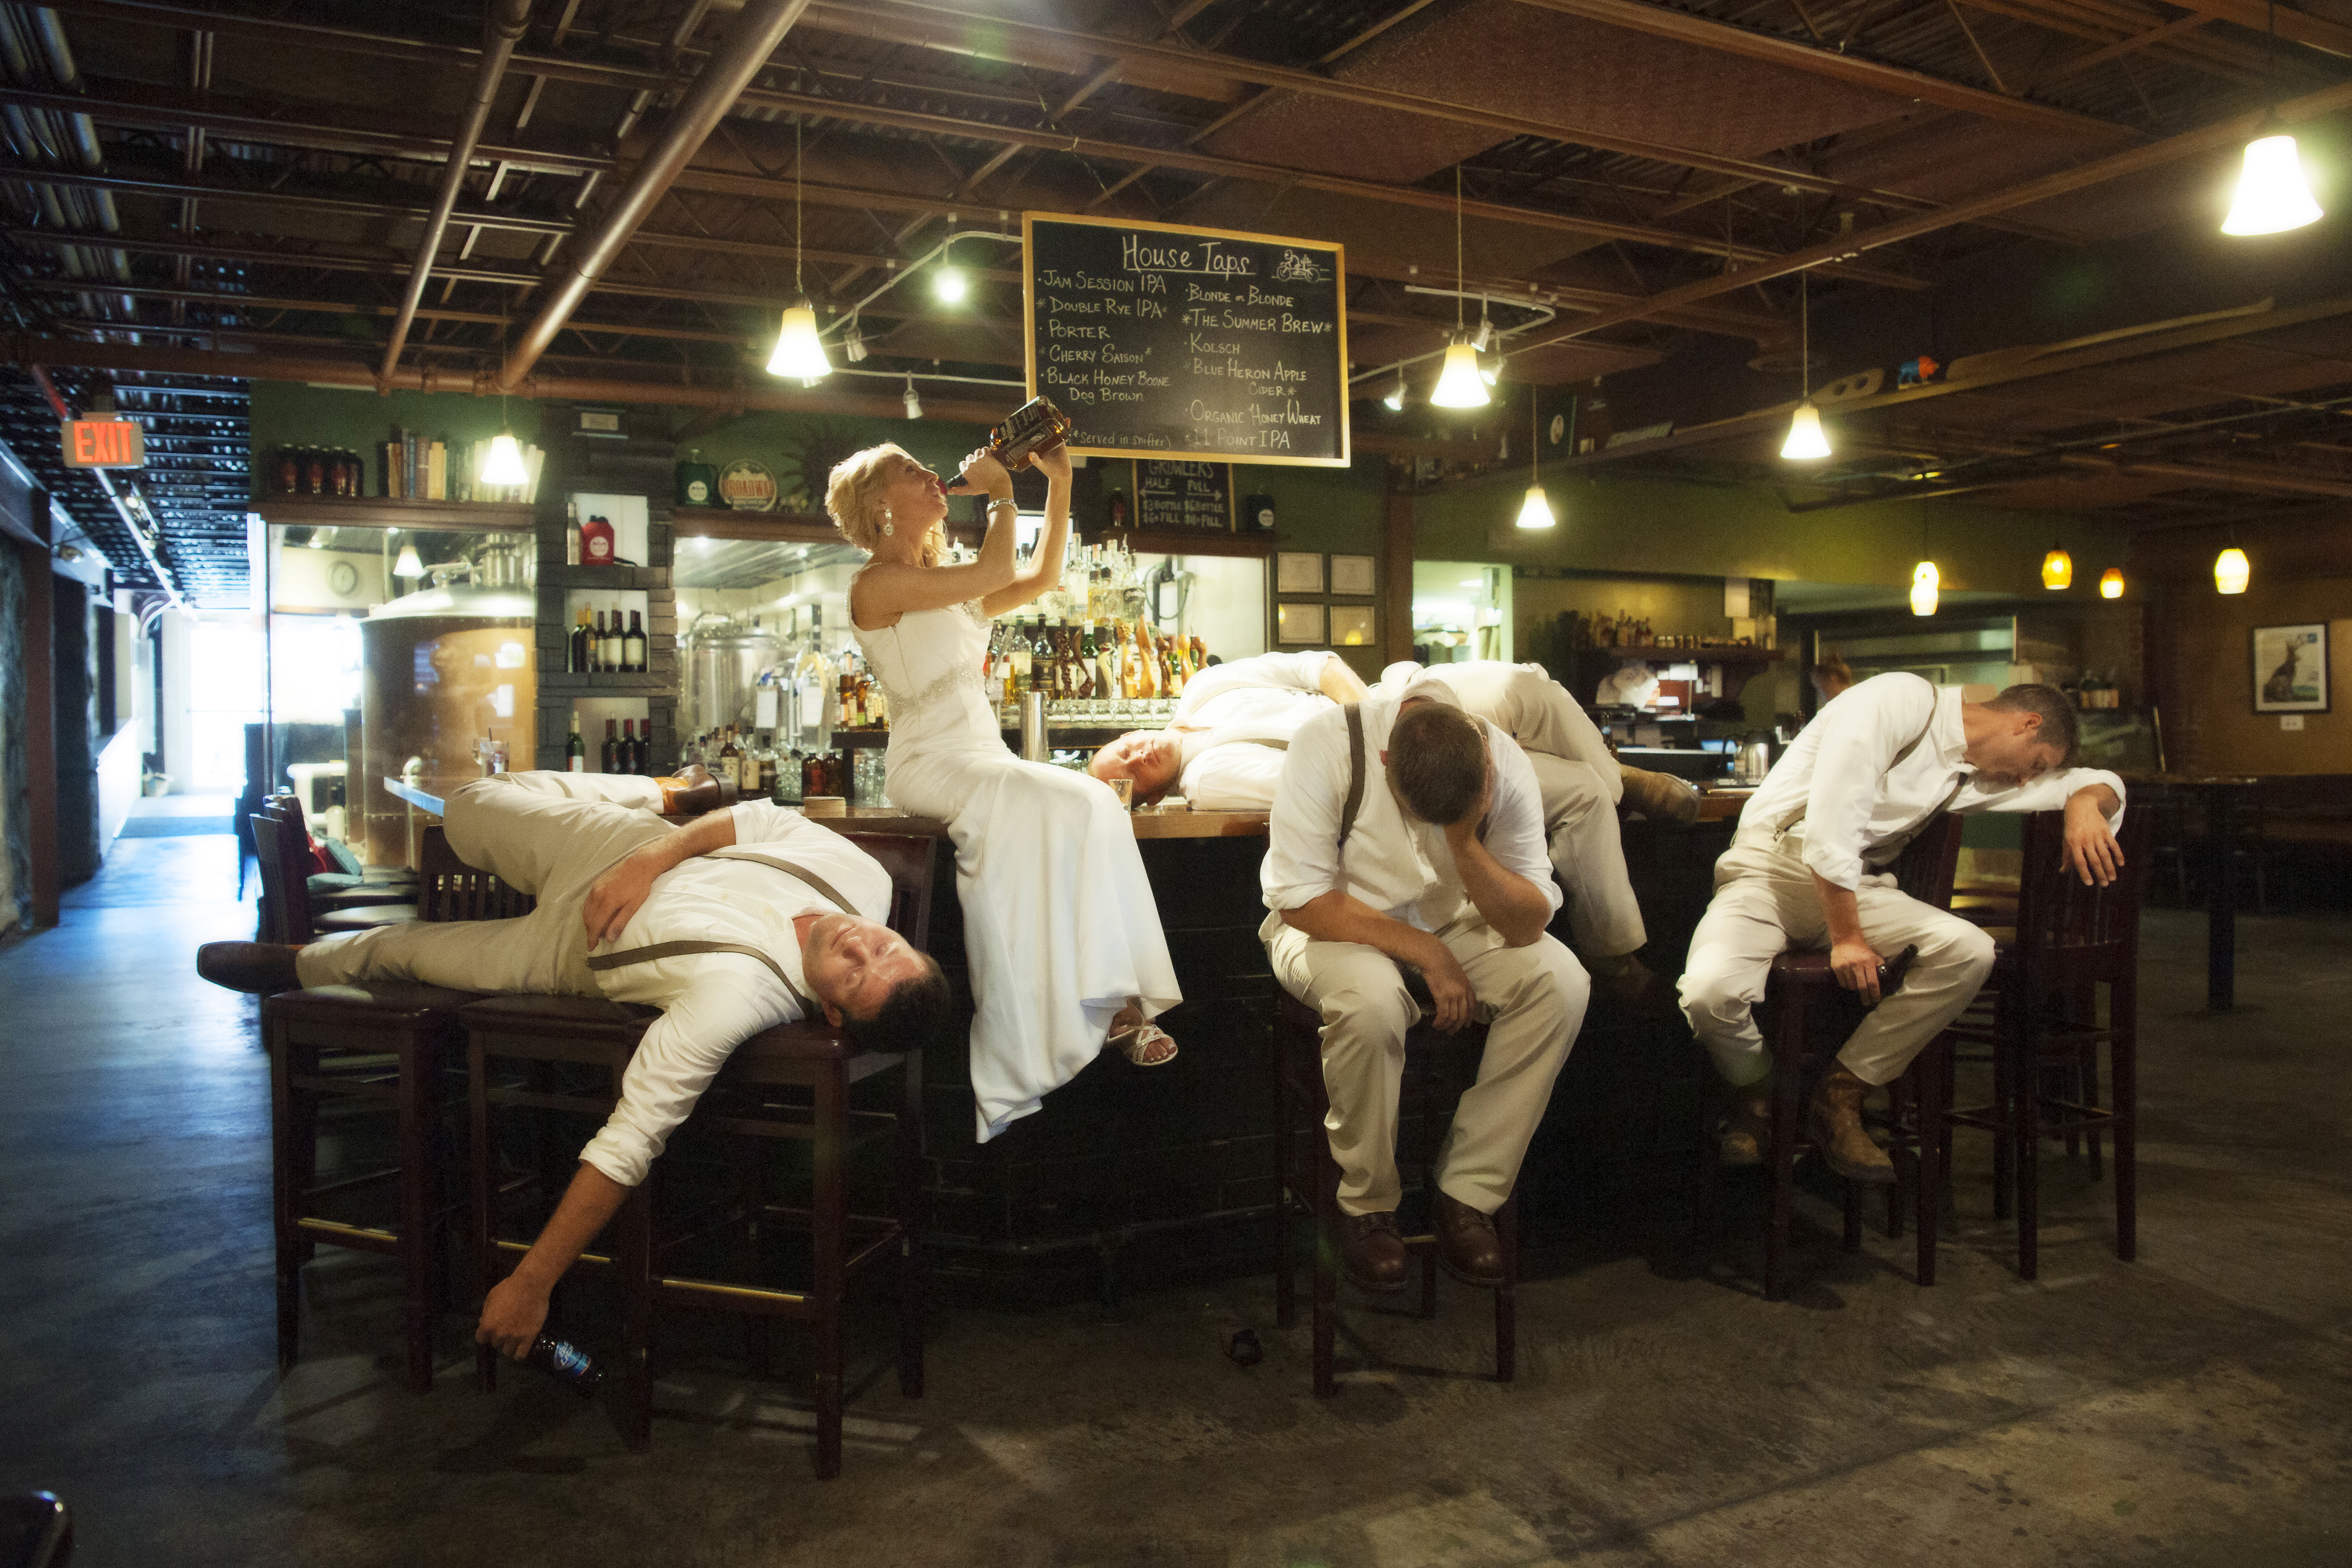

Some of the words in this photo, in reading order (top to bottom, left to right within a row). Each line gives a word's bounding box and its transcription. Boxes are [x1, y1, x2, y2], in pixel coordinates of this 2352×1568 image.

[1123, 234, 1192, 272] House
[1199, 241, 1250, 281] Taps
[1043, 270, 1072, 288] JAM
[1076, 271, 1134, 292] SESSION
[1141, 274, 1166, 293] IPA
[1049, 296, 1101, 313] DOUBLE
[1105, 298, 1131, 315] RYE
[1188, 282, 1231, 303] BLONDE
[1248, 284, 1295, 307] BLONDE
[1049, 319, 1110, 339] PORTER
[1222, 310, 1276, 332] SUMMER
[1049, 344, 1096, 363] CHERRY
[1191, 332, 1240, 354] KOLSCH
[1047, 366, 1089, 385] BLACK
[1094, 369, 1135, 386] HONEY
[1193, 357, 1224, 376] BLUE
[1227, 357, 1271, 379] HERON
[1273, 360, 1307, 381] APPLE
[1068, 388, 1094, 405] Dog
[1100, 388, 1144, 402] Brown
[1190, 399, 1245, 424] ORGANIC
[1248, 403, 1285, 425] HONEY
[1287, 399, 1322, 424] WHEAT
[73, 422, 133, 463] EXIT
[1259, 430, 1290, 449] IPA
